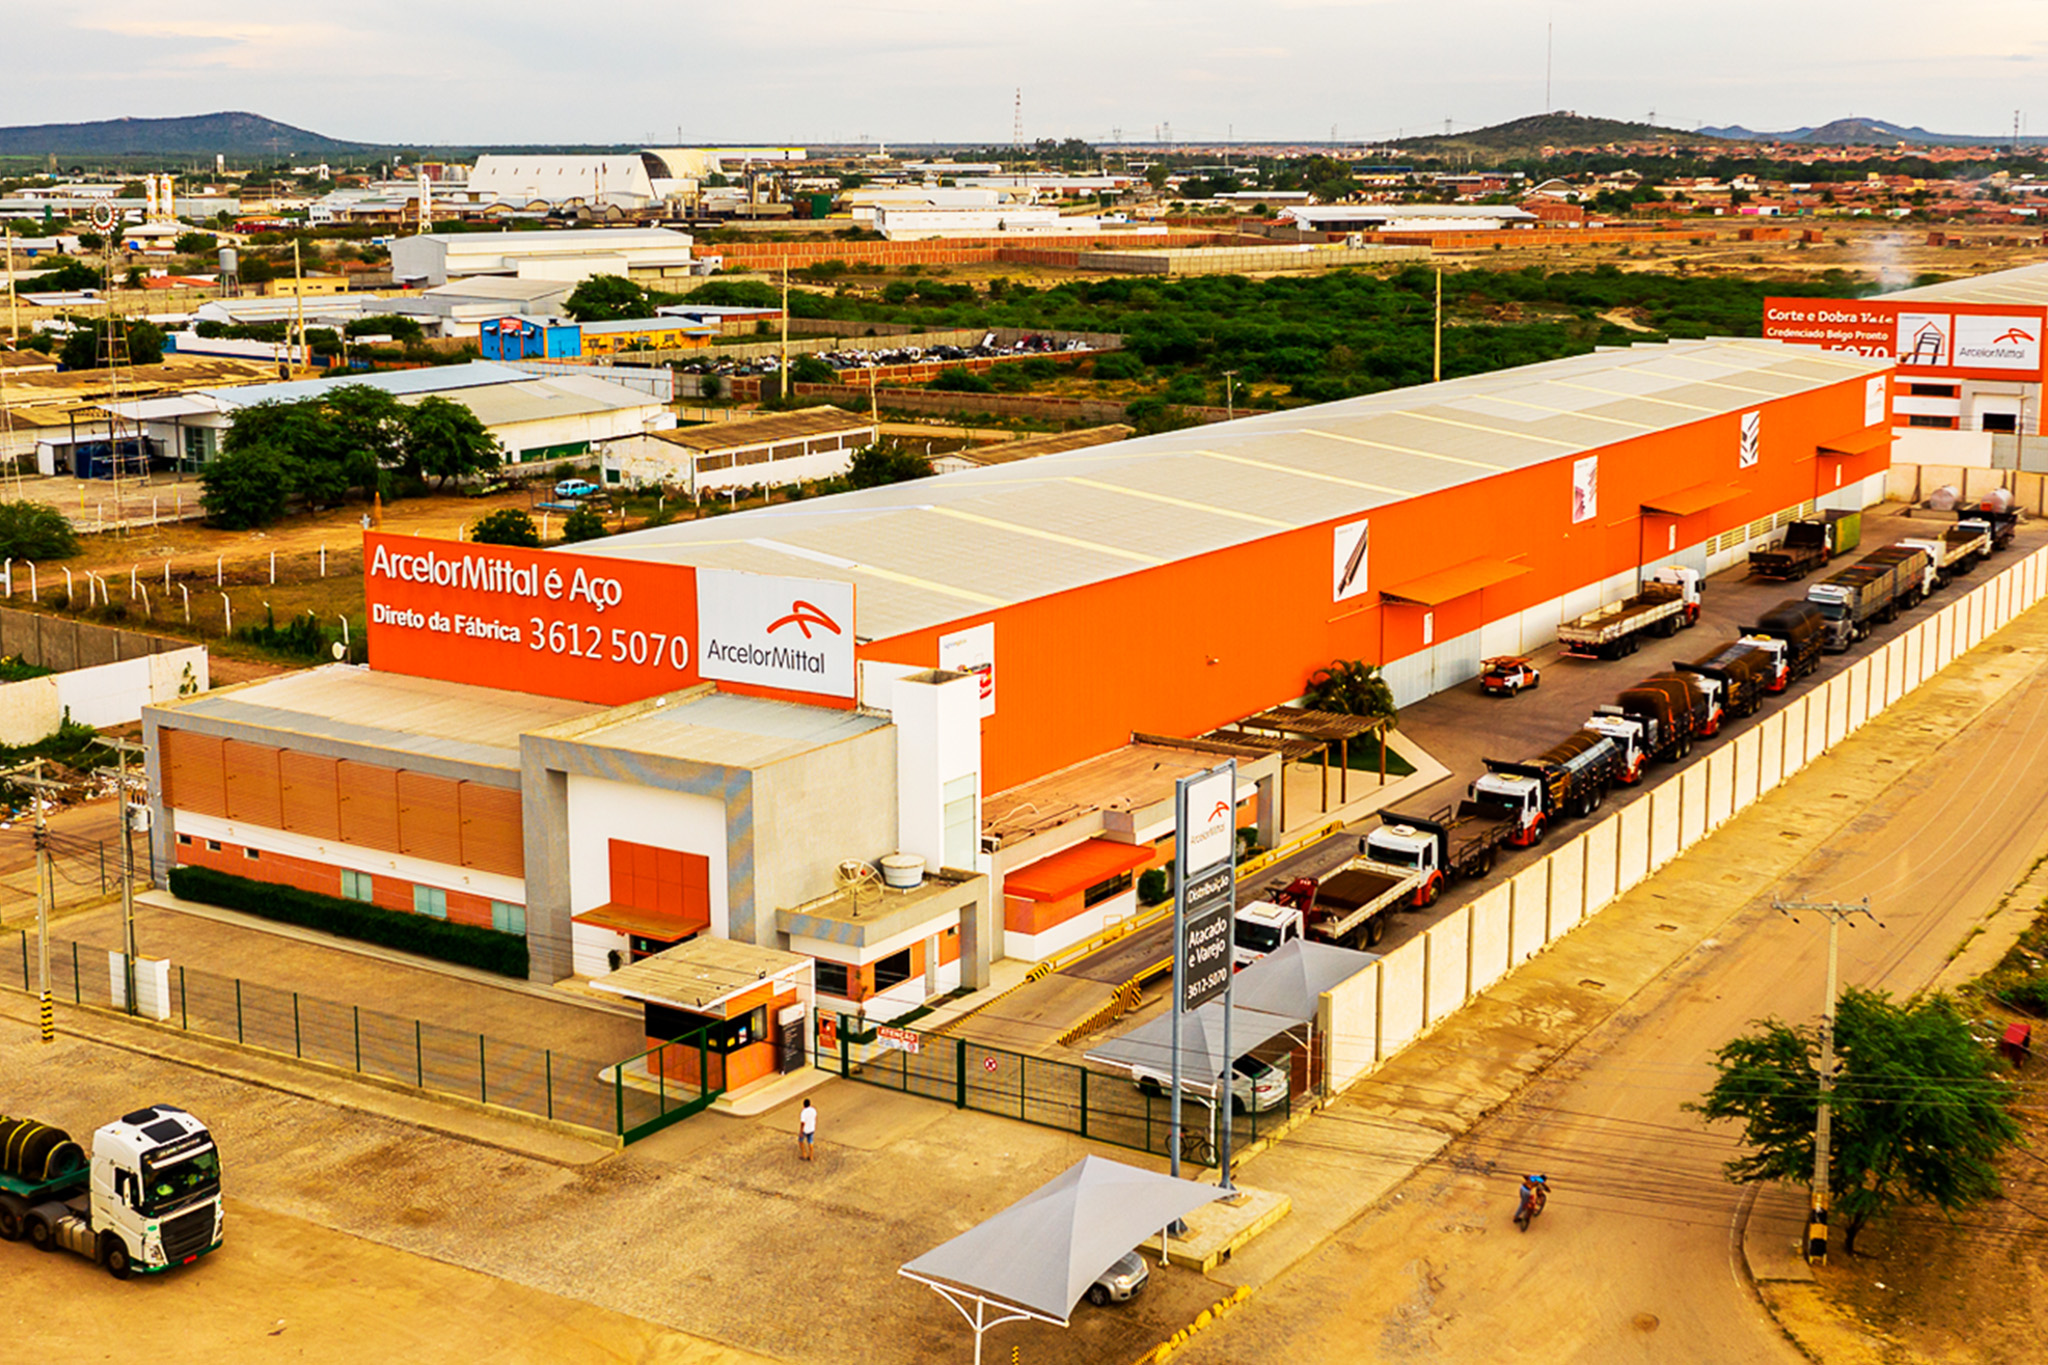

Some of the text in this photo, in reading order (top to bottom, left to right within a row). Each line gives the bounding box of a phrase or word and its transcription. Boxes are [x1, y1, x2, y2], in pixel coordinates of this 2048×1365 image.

[1767, 308, 1805, 321] Corte
[1807, 312, 1816, 322] e
[1818, 311, 1858, 323] Dobra
[1767, 327, 1889, 343] Credenciado Belgo Pronto
[1959, 347, 2025, 359] ArcelorMittal
[371, 545, 623, 612] ArcelorMittal é Aço
[373, 603, 690, 671] Direto da Fábrica 3612 5070
[707, 639, 827, 675] ArcelorMittal
[1187, 875, 1230, 904] Distribuição
[1188, 917, 1228, 949] Atacado
[1188, 938, 1226, 968] e Varejo
[1187, 967, 1228, 1000] 3612-5070
